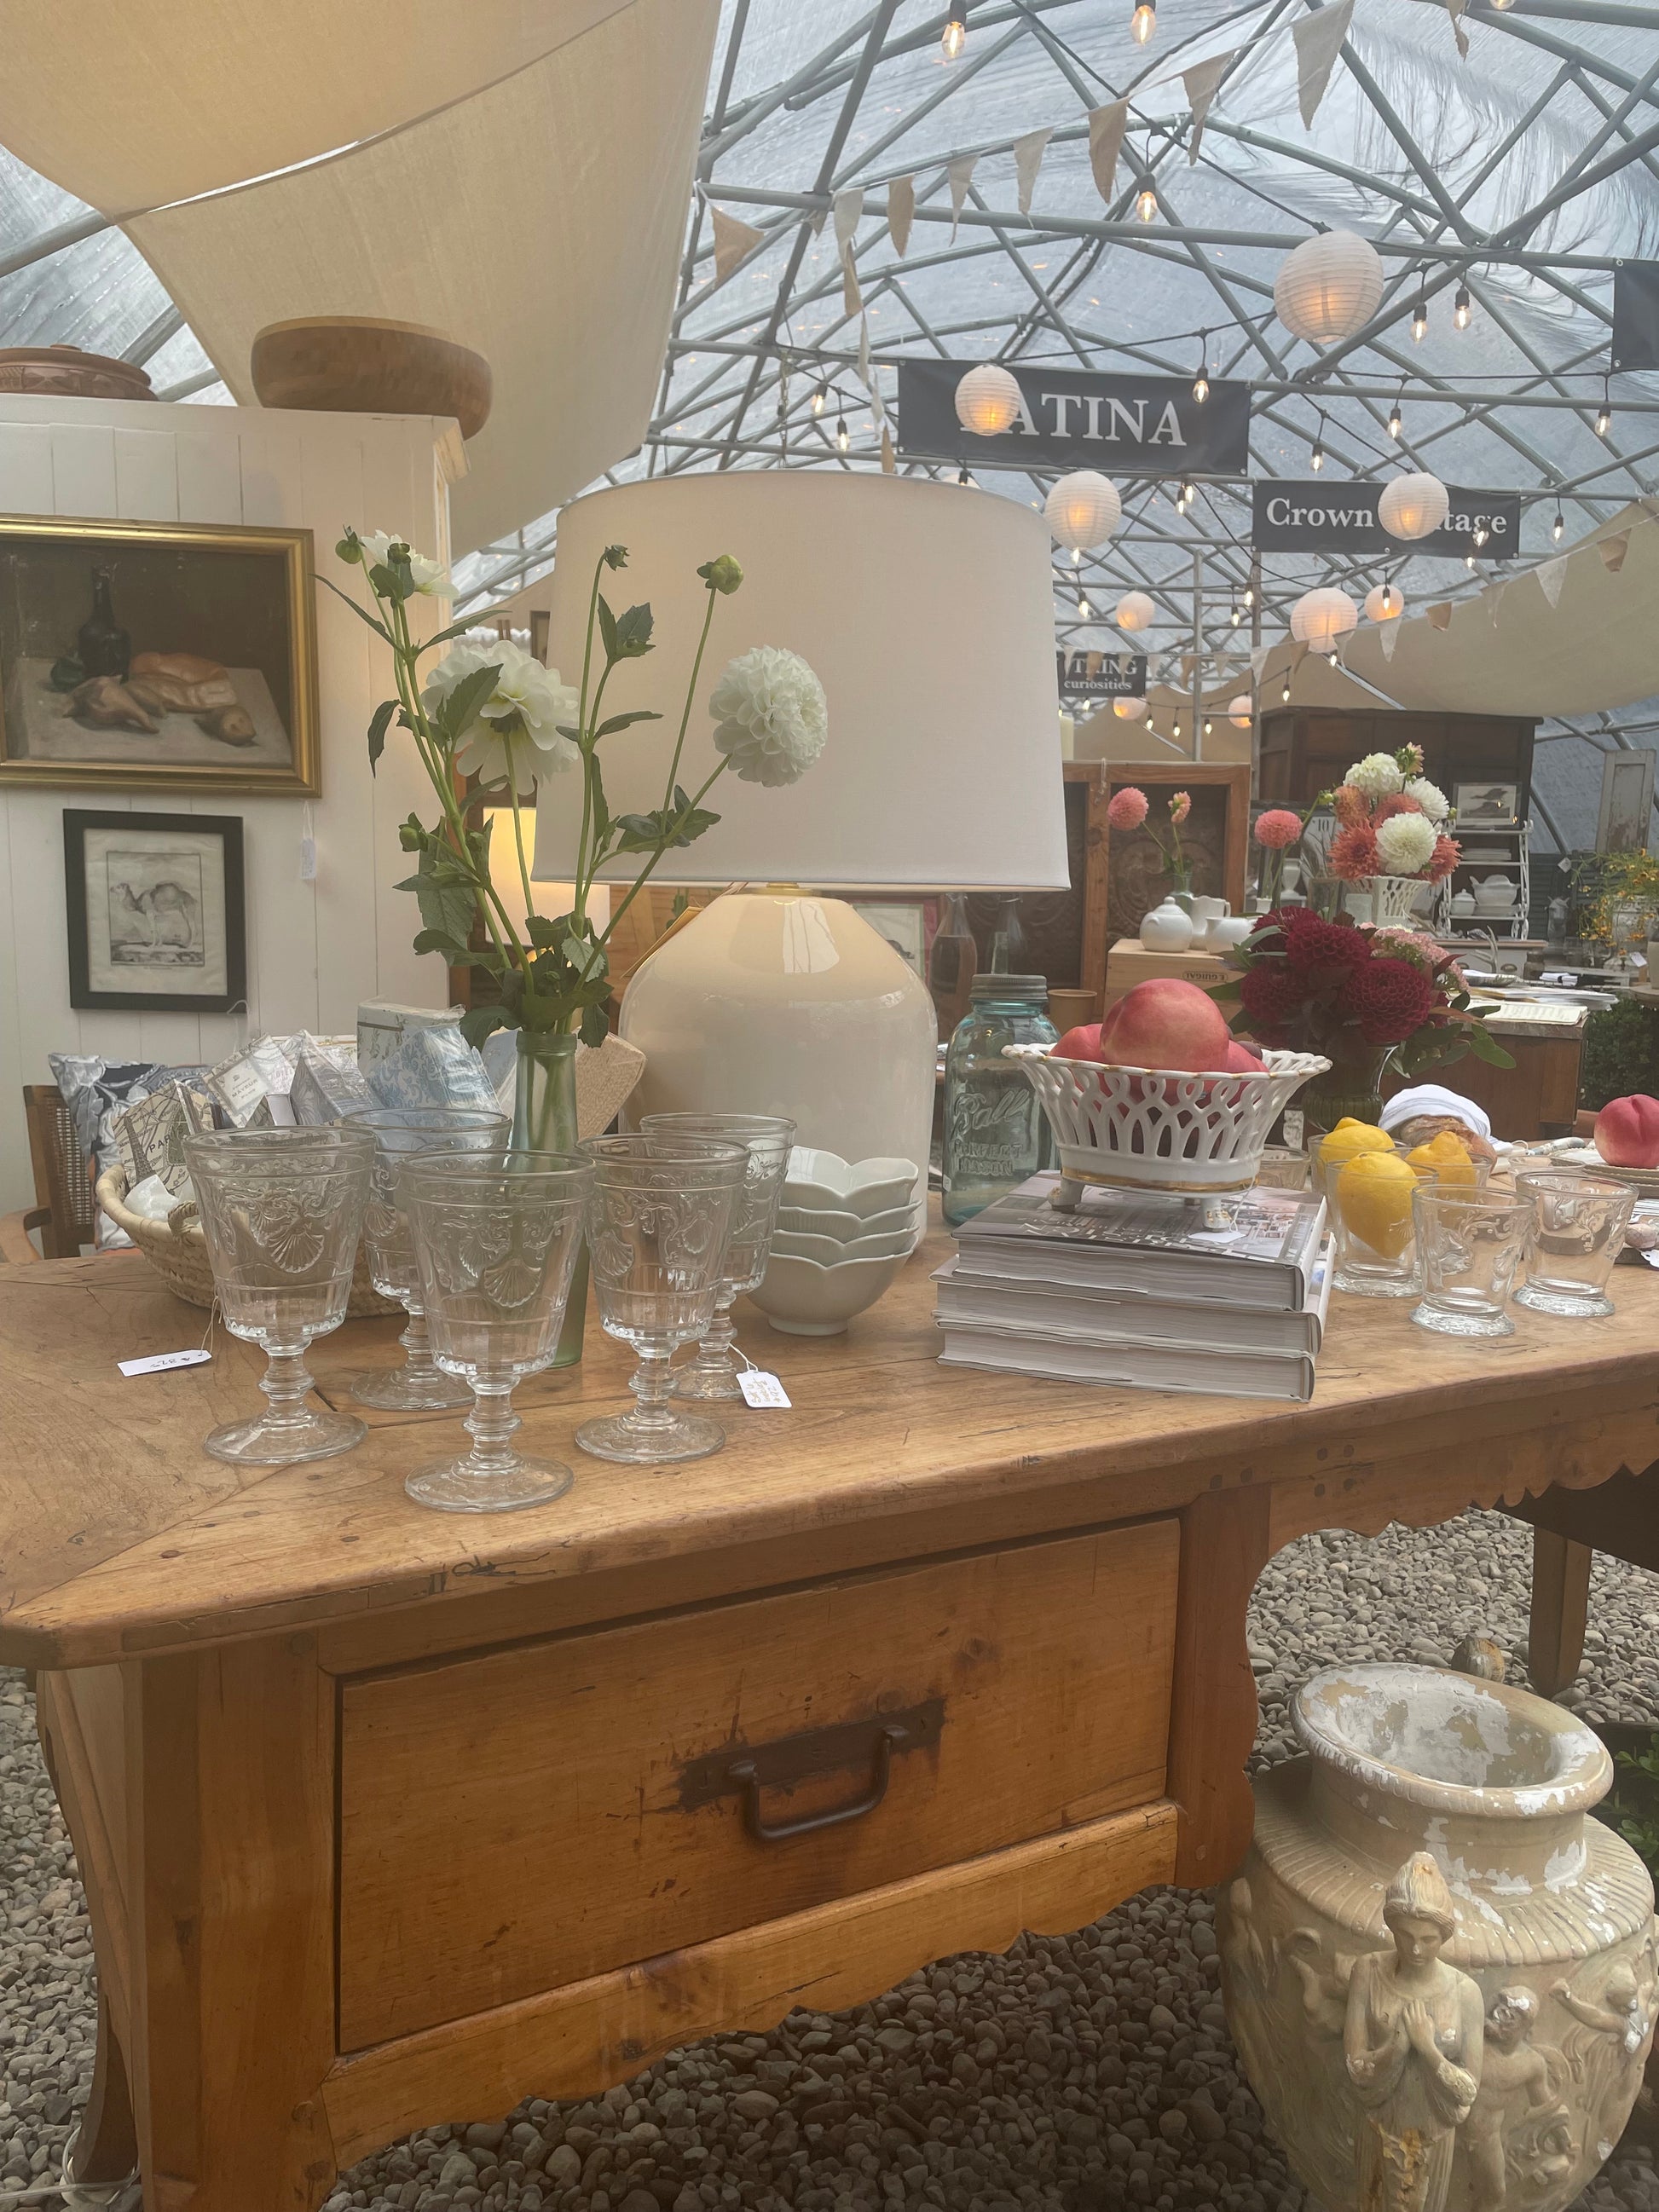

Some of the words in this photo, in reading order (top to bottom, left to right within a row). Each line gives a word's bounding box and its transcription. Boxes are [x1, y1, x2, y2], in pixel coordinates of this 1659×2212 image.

[960, 393, 1188, 447] ATINA
[1266, 498, 1375, 528] Crown
[1063, 679, 1133, 690] curiosities
[952, 1089, 1030, 1140] Ball
